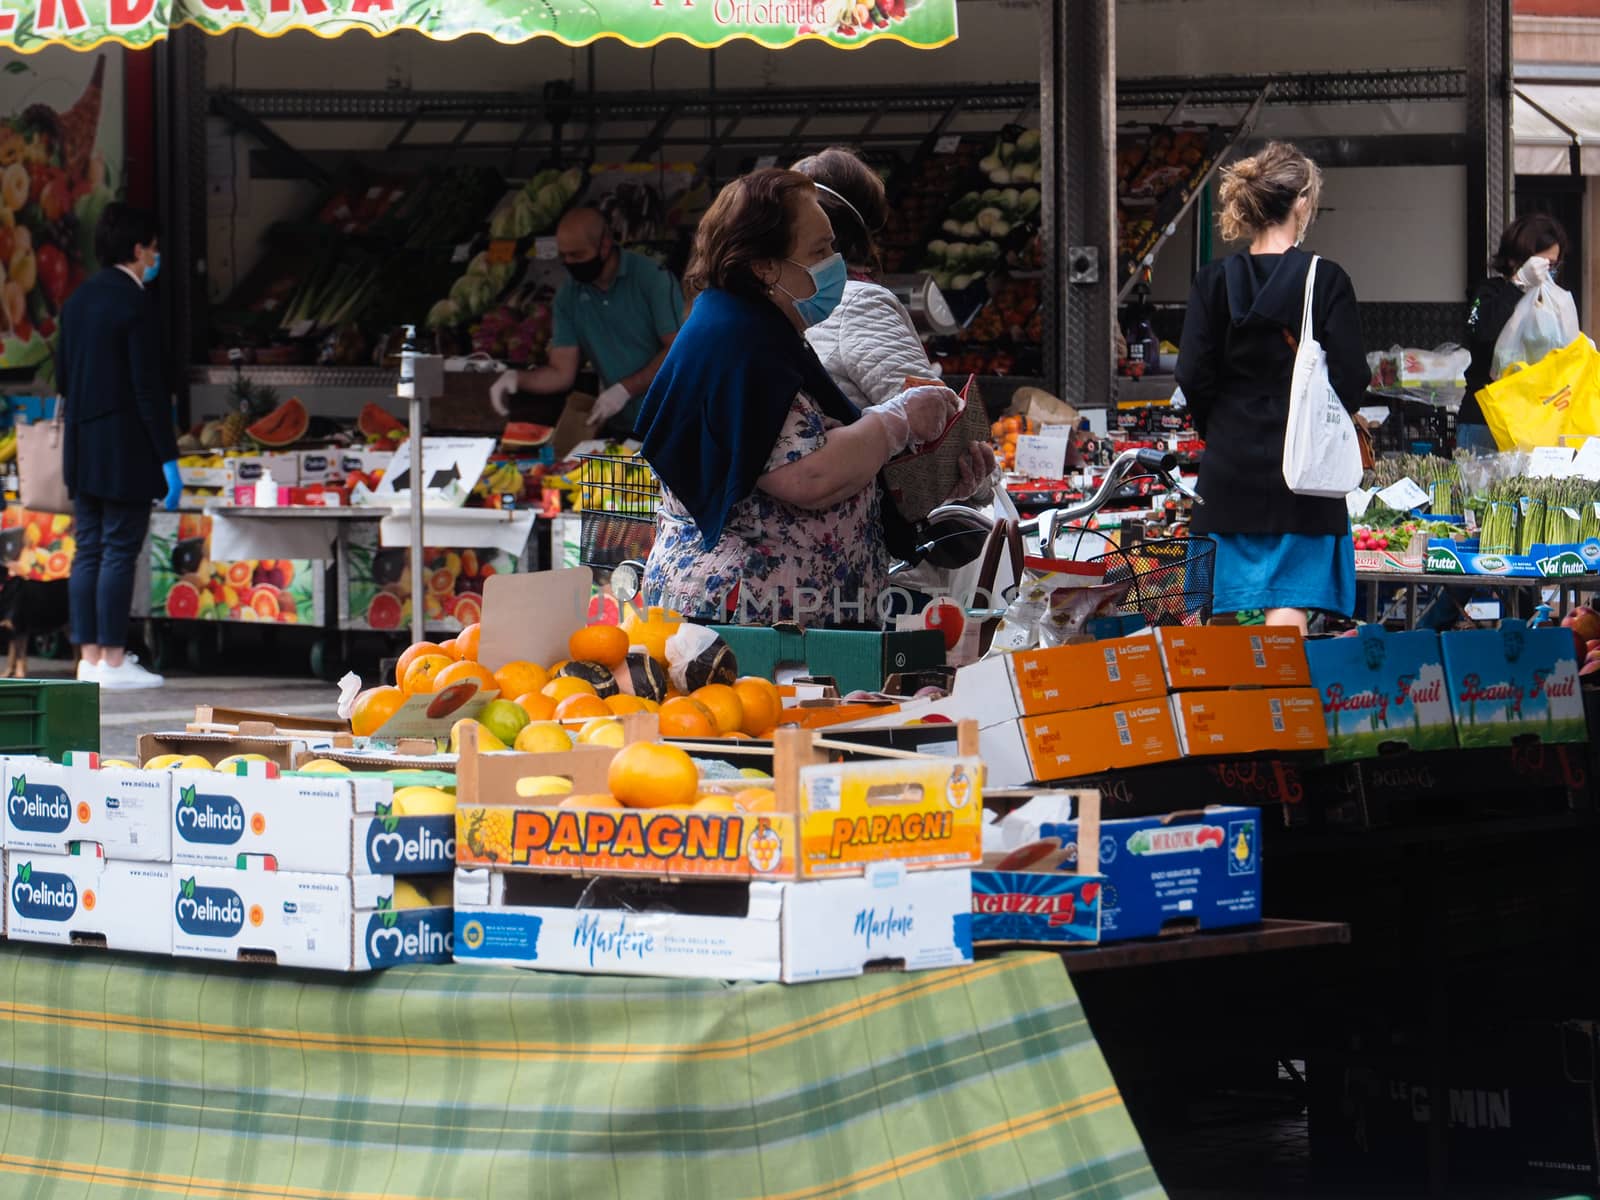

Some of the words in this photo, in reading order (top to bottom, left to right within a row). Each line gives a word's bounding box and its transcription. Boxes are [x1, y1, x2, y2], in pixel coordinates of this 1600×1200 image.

[714, 0, 827, 24] Ortofrutta
[1427, 555, 1456, 570] frutta
[1543, 563, 1558, 575] Val
[1561, 561, 1584, 574] frutta
[1044, 689, 1058, 700] you
[1324, 682, 1388, 720] Beauty
[1395, 674, 1441, 704] Fruit
[1460, 673, 1523, 712] Beauty
[1530, 668, 1575, 698] Fruit
[121, 780, 160, 789] www.melinda.it
[299, 790, 340, 798] www.melinda.it
[10, 793, 69, 819] Melinda
[178, 804, 242, 831] Melinda
[511, 809, 744, 865] PAPAGNI
[830, 811, 954, 859] PAPAGNI
[130, 870, 169, 878] www.melinda.it
[299, 882, 339, 891] www.melinda.it
[15, 881, 74, 908] Melinda
[178, 896, 241, 923] Melinda
[573, 912, 655, 967] Marlene
[854, 906, 914, 950] Marlene
[1411, 1086, 1512, 1129] GMIN
